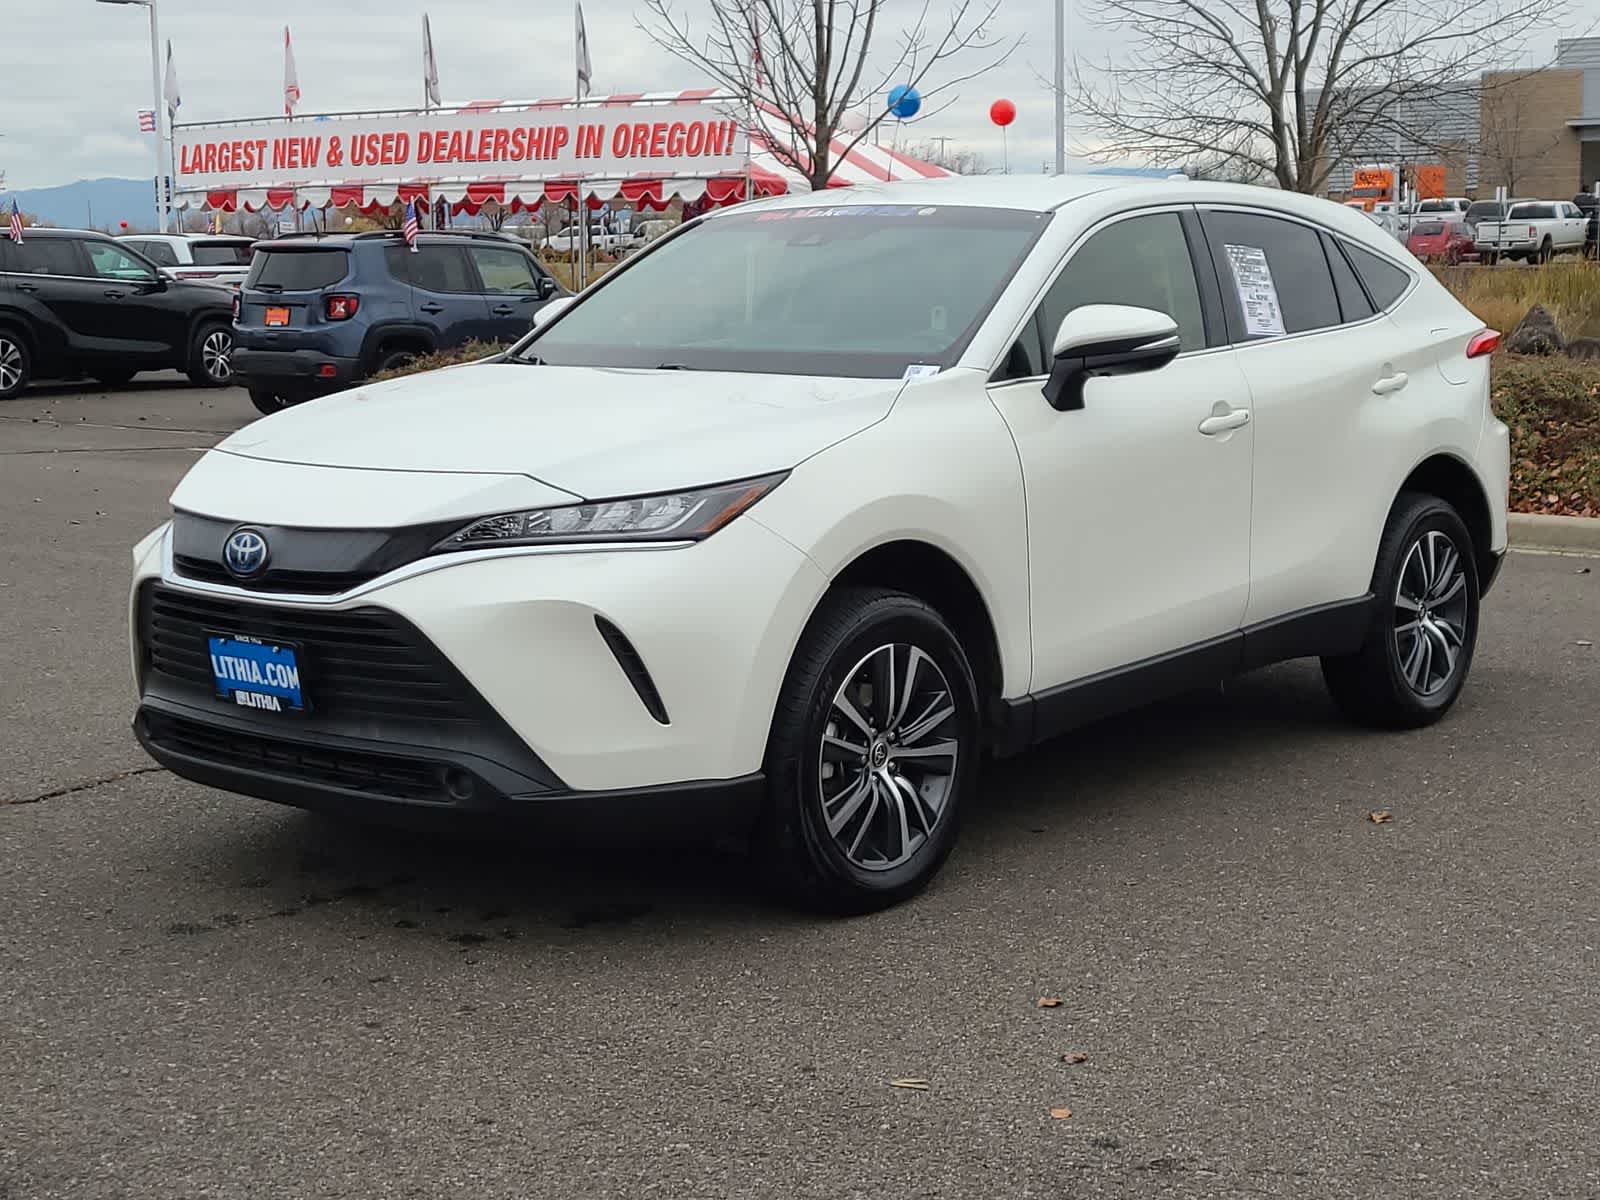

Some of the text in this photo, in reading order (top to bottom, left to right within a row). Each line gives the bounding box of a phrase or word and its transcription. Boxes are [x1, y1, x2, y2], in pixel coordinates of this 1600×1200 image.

[180, 119, 738, 175] LARGEST NEW & USED DEALERSHIP IN OREGON!
[210, 654, 301, 690] LITHIA.COM
[246, 692, 282, 712] LITHIA
